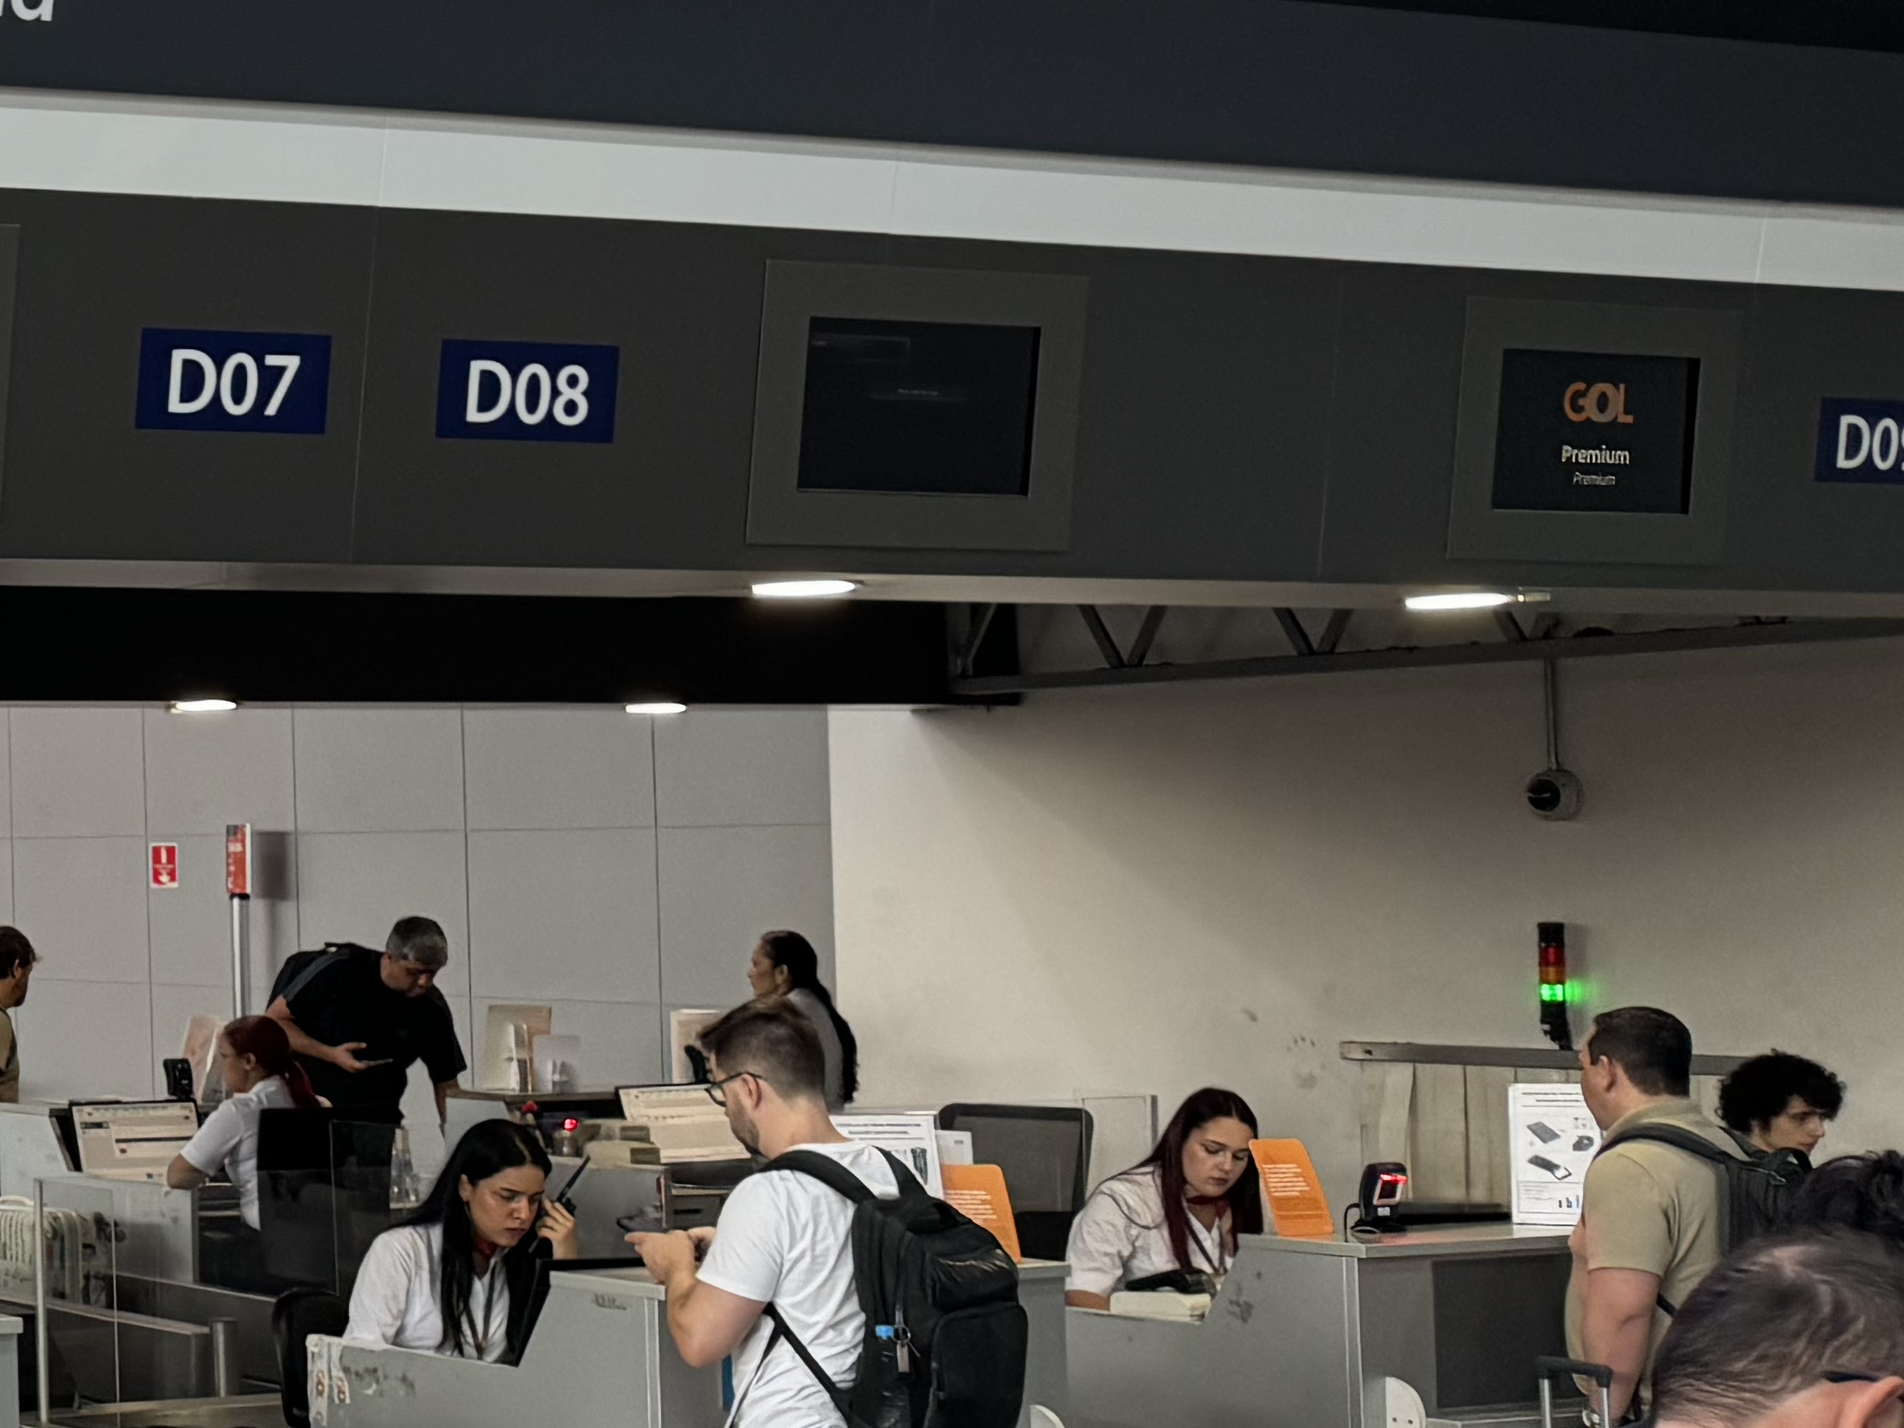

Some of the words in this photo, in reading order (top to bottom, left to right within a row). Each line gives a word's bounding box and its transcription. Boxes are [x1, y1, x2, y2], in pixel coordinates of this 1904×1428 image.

[167, 348, 301, 417] D07
[465, 359, 590, 427] D08
[1563, 381, 1634, 424] GOL
[1561, 444, 1630, 465] Premium
[1836, 414, 1904, 471] D0
[1572, 471, 1616, 486] Premium
